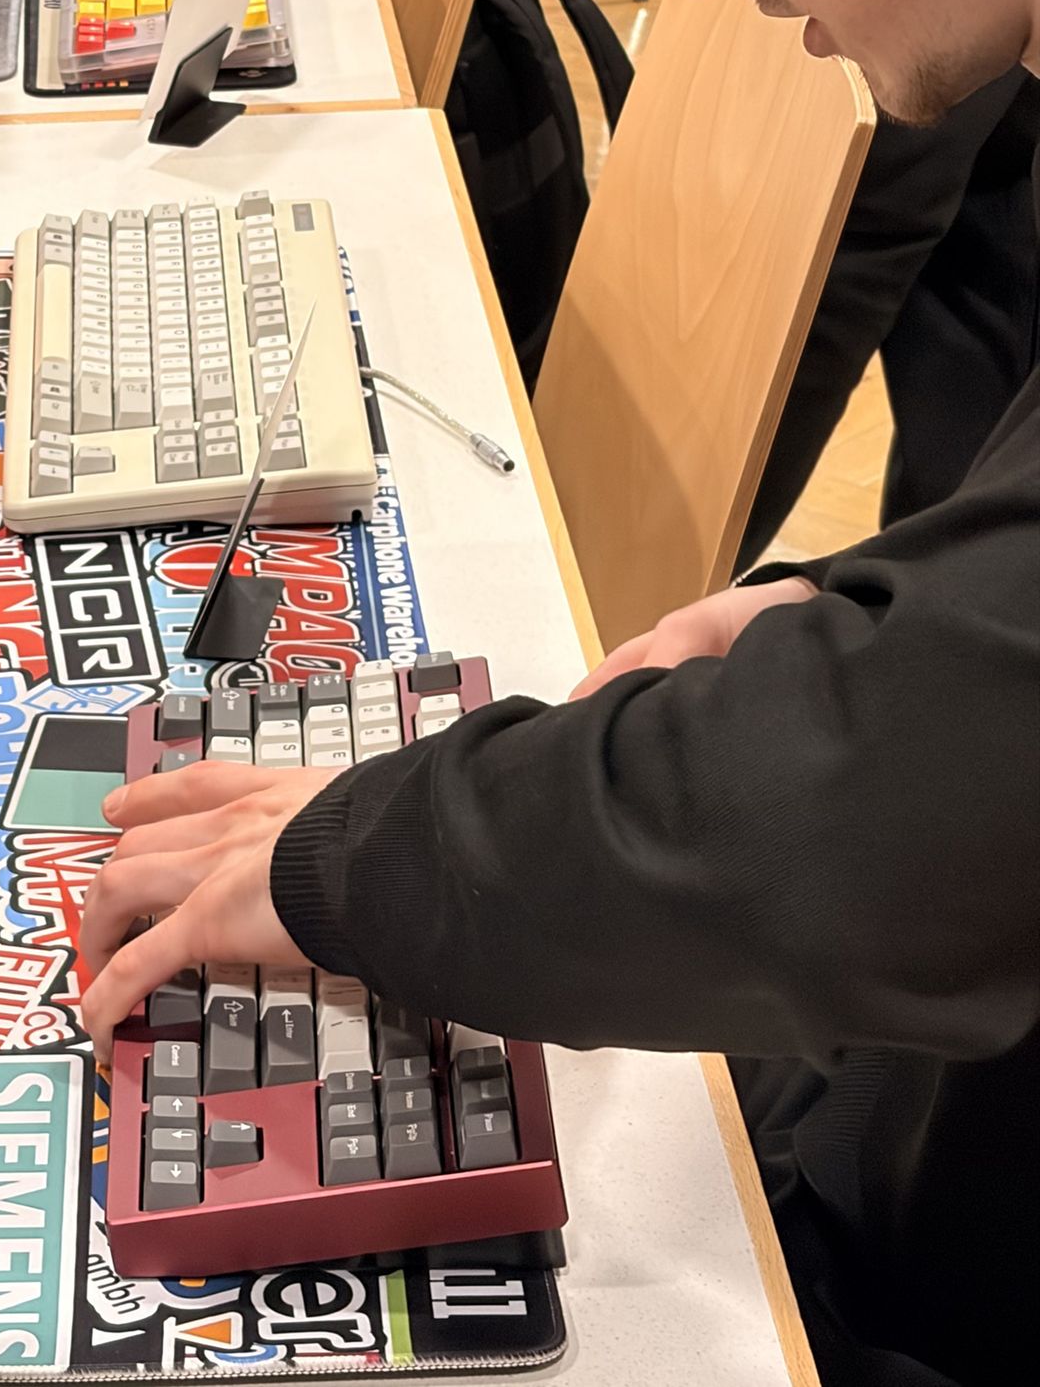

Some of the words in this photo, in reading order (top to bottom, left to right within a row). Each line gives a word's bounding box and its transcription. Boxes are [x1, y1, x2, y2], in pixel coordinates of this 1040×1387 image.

[369, 495, 404, 583] Carphone
[60, 541, 137, 674] NCR
[330, 706, 344, 714] Q
[331, 728, 345, 737] W
[233, 738, 248, 746] Z
[282, 744, 297, 752] S
[332, 751, 346, 759] E
[284, 1022, 295, 1040] Enter
[170, 1044, 182, 1067] Control
[346, 1104, 357, 1119] End
